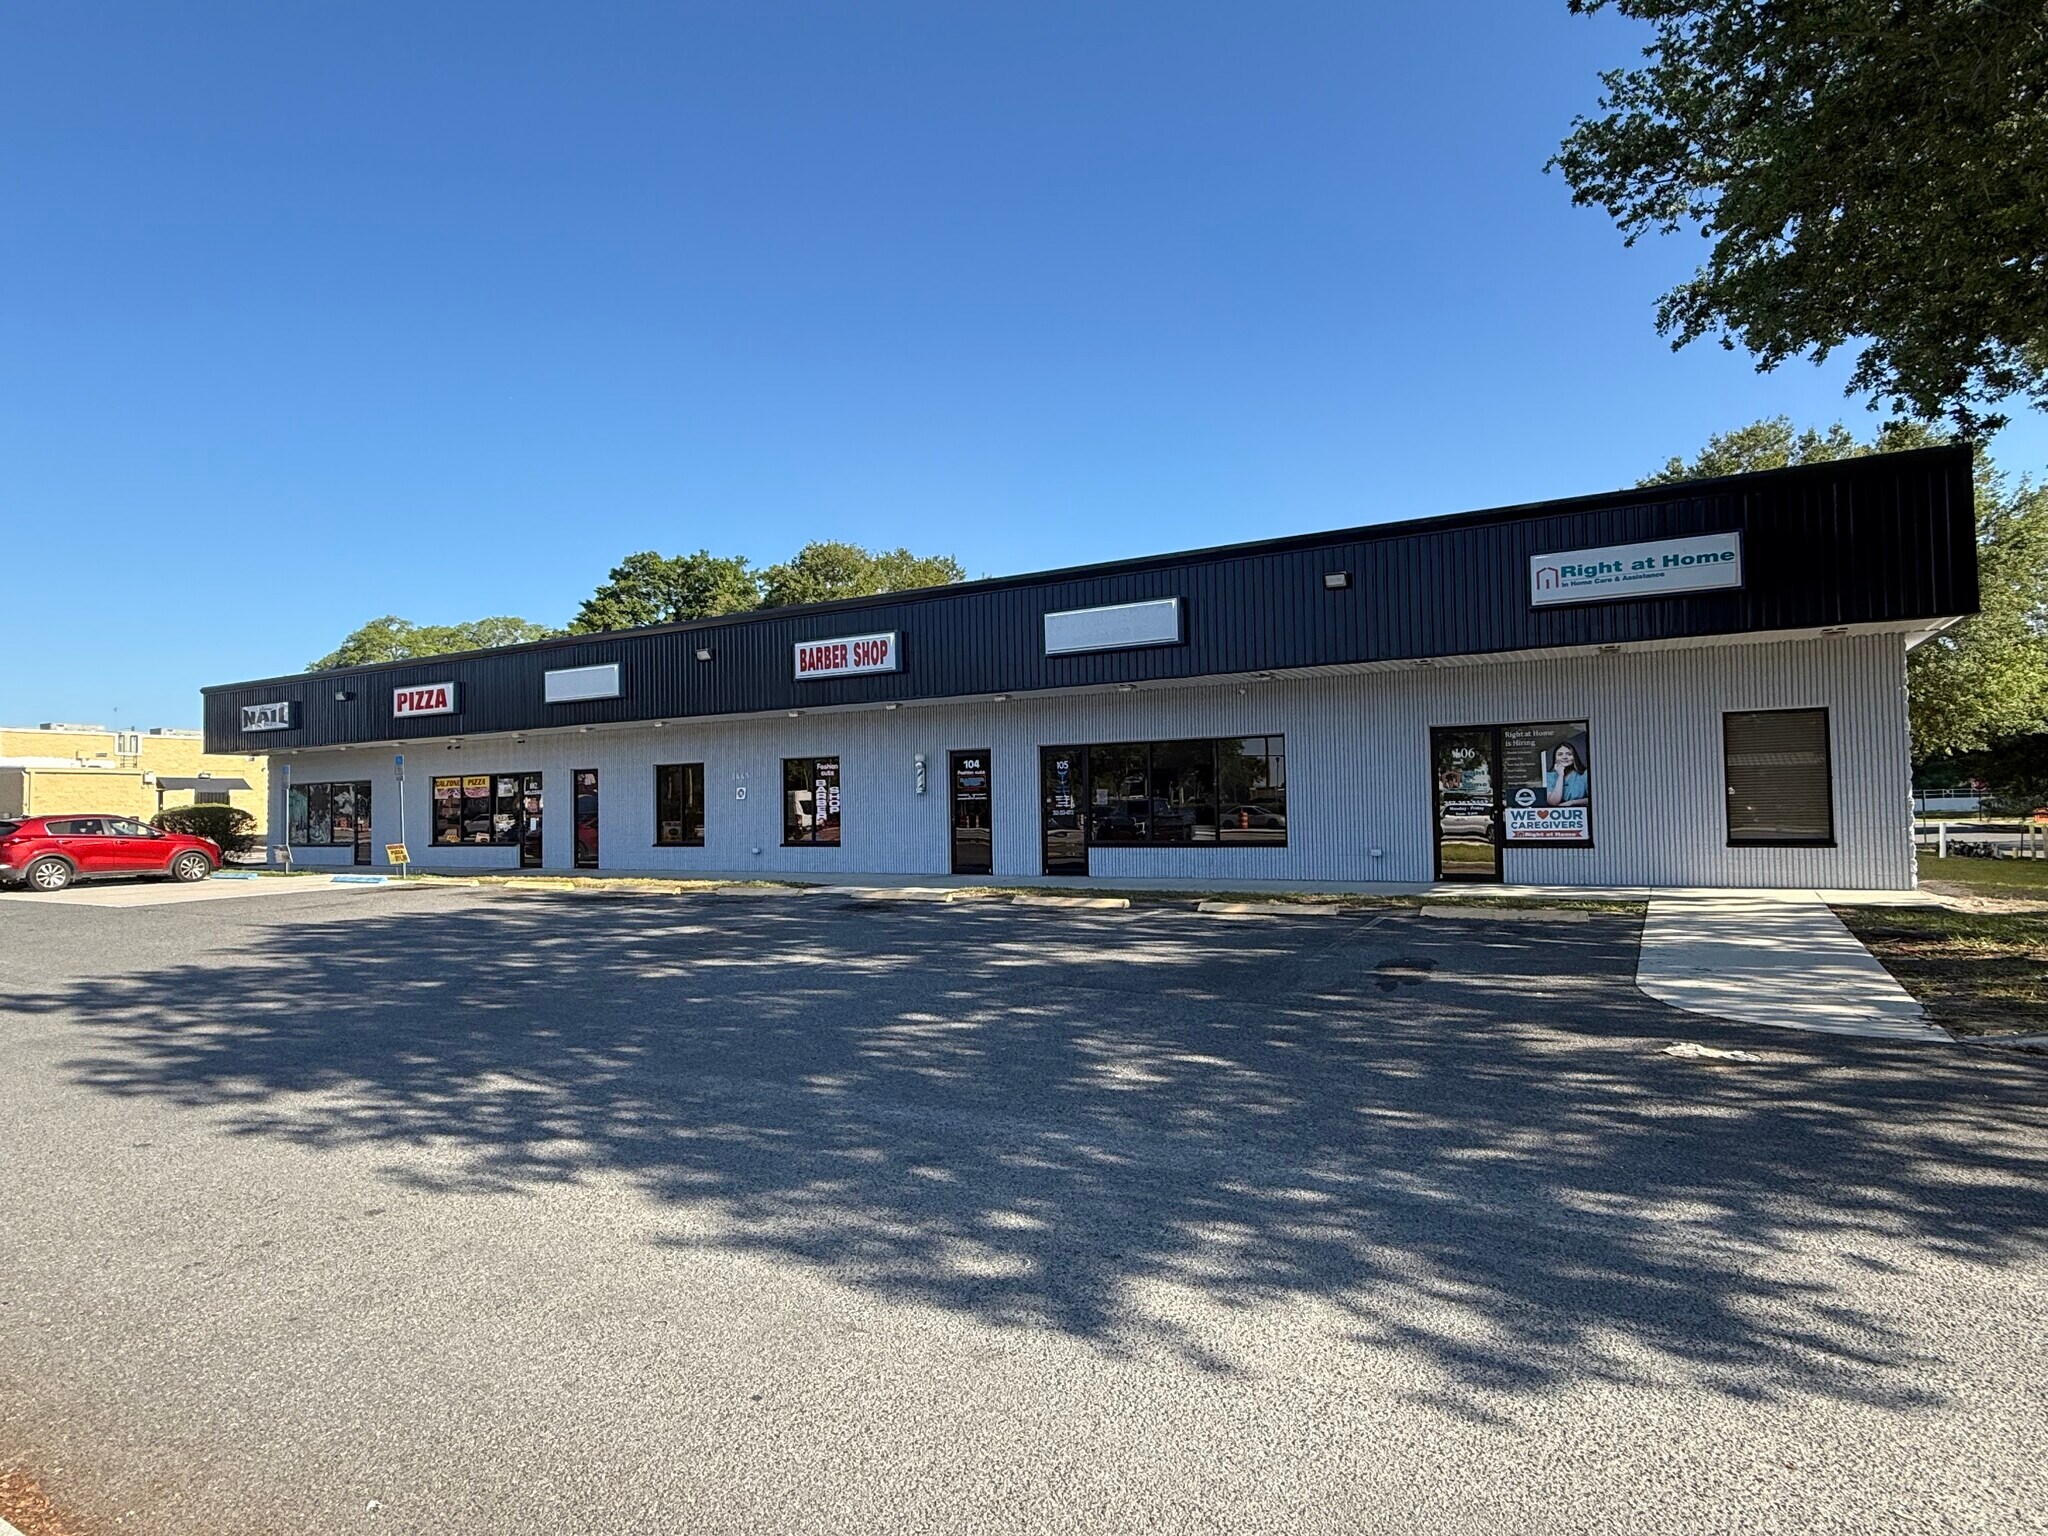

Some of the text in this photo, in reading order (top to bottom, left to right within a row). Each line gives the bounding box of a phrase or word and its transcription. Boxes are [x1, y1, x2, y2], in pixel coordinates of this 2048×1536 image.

[1561, 551, 1735, 578] Right at Home
[1594, 577, 1612, 585] Care
[1622, 571, 1665, 581] Assistance
[800, 640, 888, 672] BARBER SHOP
[397, 688, 448, 712] PIZZA
[243, 706, 288, 728] NAIL
[1504, 731, 1524, 739] Right
[963, 760, 980, 769] 104
[1056, 761, 1069, 769] 105
[815, 779, 827, 820] BARBER
[829, 787, 840, 814] SHOP
[1511, 810, 1583, 820] WE OUR
[1511, 821, 1583, 829] CAREGIVERS
